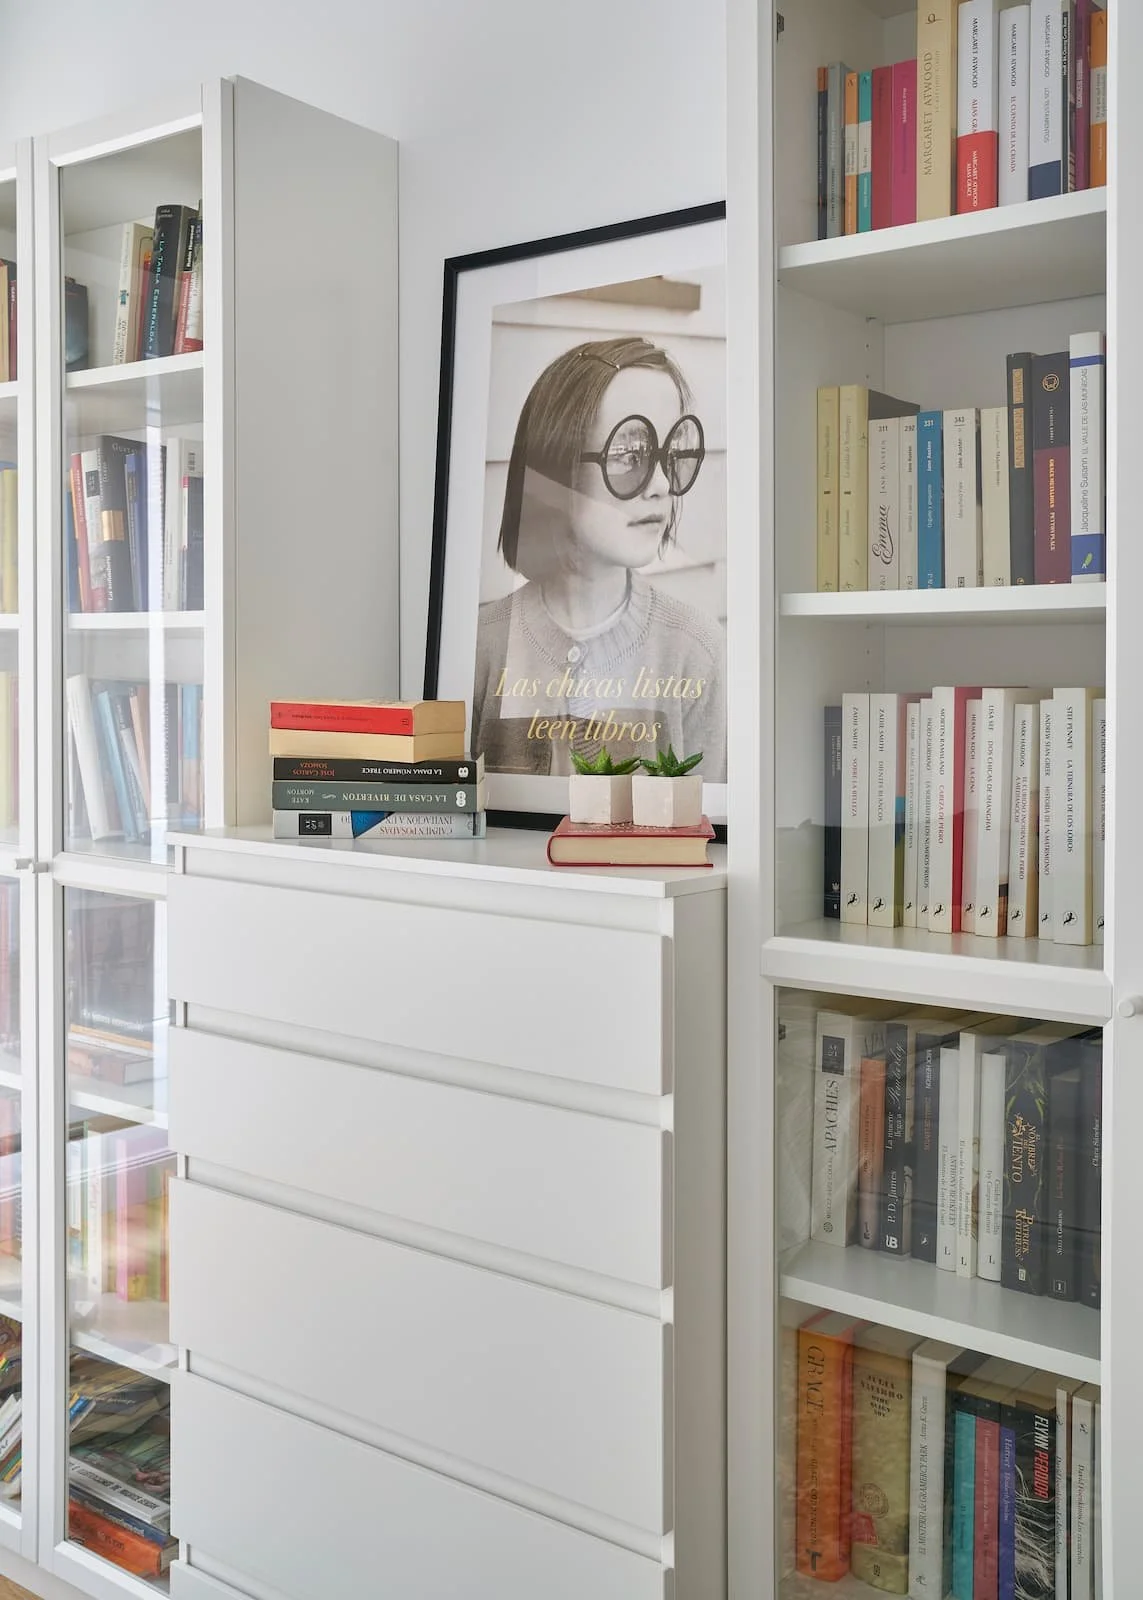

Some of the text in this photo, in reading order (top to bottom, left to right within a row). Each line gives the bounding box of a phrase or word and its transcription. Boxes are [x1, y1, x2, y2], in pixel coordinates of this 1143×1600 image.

[923, 52, 933, 175] MARGARET ATWOOD
[872, 504, 894, 566] Emma
[492, 666, 706, 699] Las chicas listas
[527, 709, 662, 743] leen libros
[362, 766, 380, 775] TRECE
[413, 768, 433, 776] DAMA
[434, 768, 442, 776] LA
[342, 792, 447, 803] LA CASA DE RIVERTON
[826, 1080, 841, 1154] APACHES
[1034, 1414, 1049, 1498] FLYNN PERDIDA
